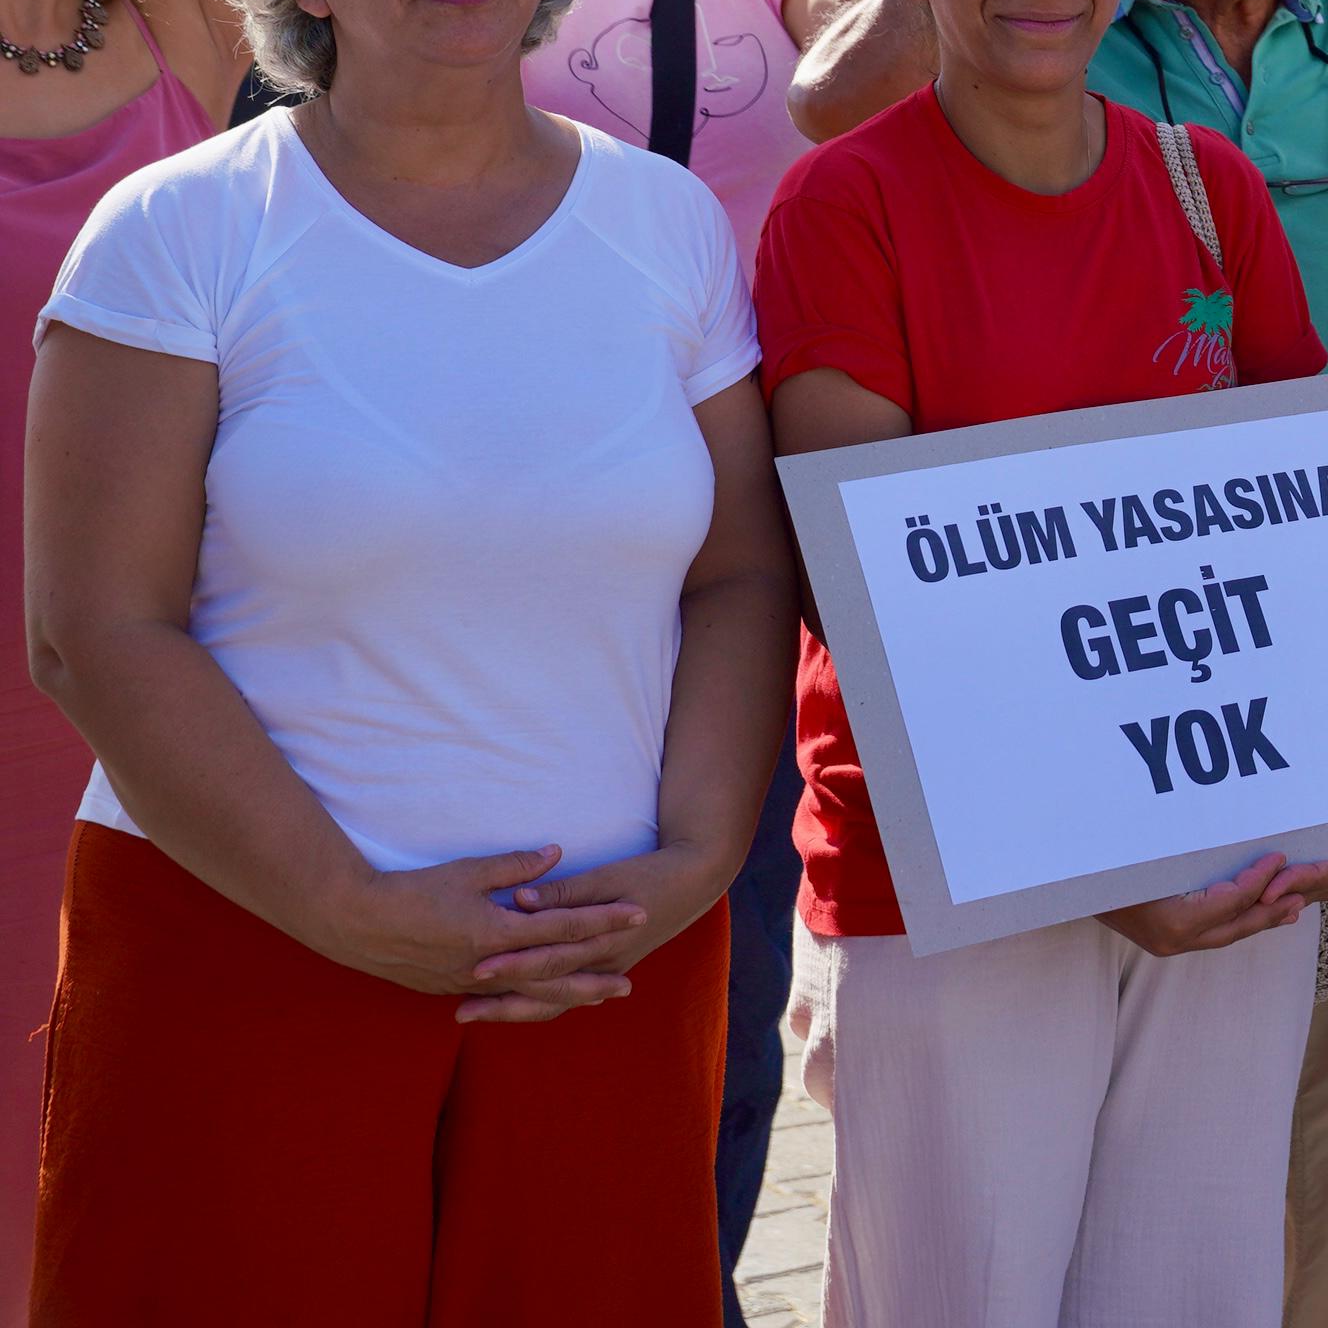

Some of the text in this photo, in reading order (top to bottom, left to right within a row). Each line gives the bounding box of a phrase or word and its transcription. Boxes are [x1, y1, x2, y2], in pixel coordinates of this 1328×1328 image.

[904, 503, 1078, 583] ÖLÜM
[1059, 564, 1275, 684] GEÇİT
[1120, 696, 1290, 794] YOK
